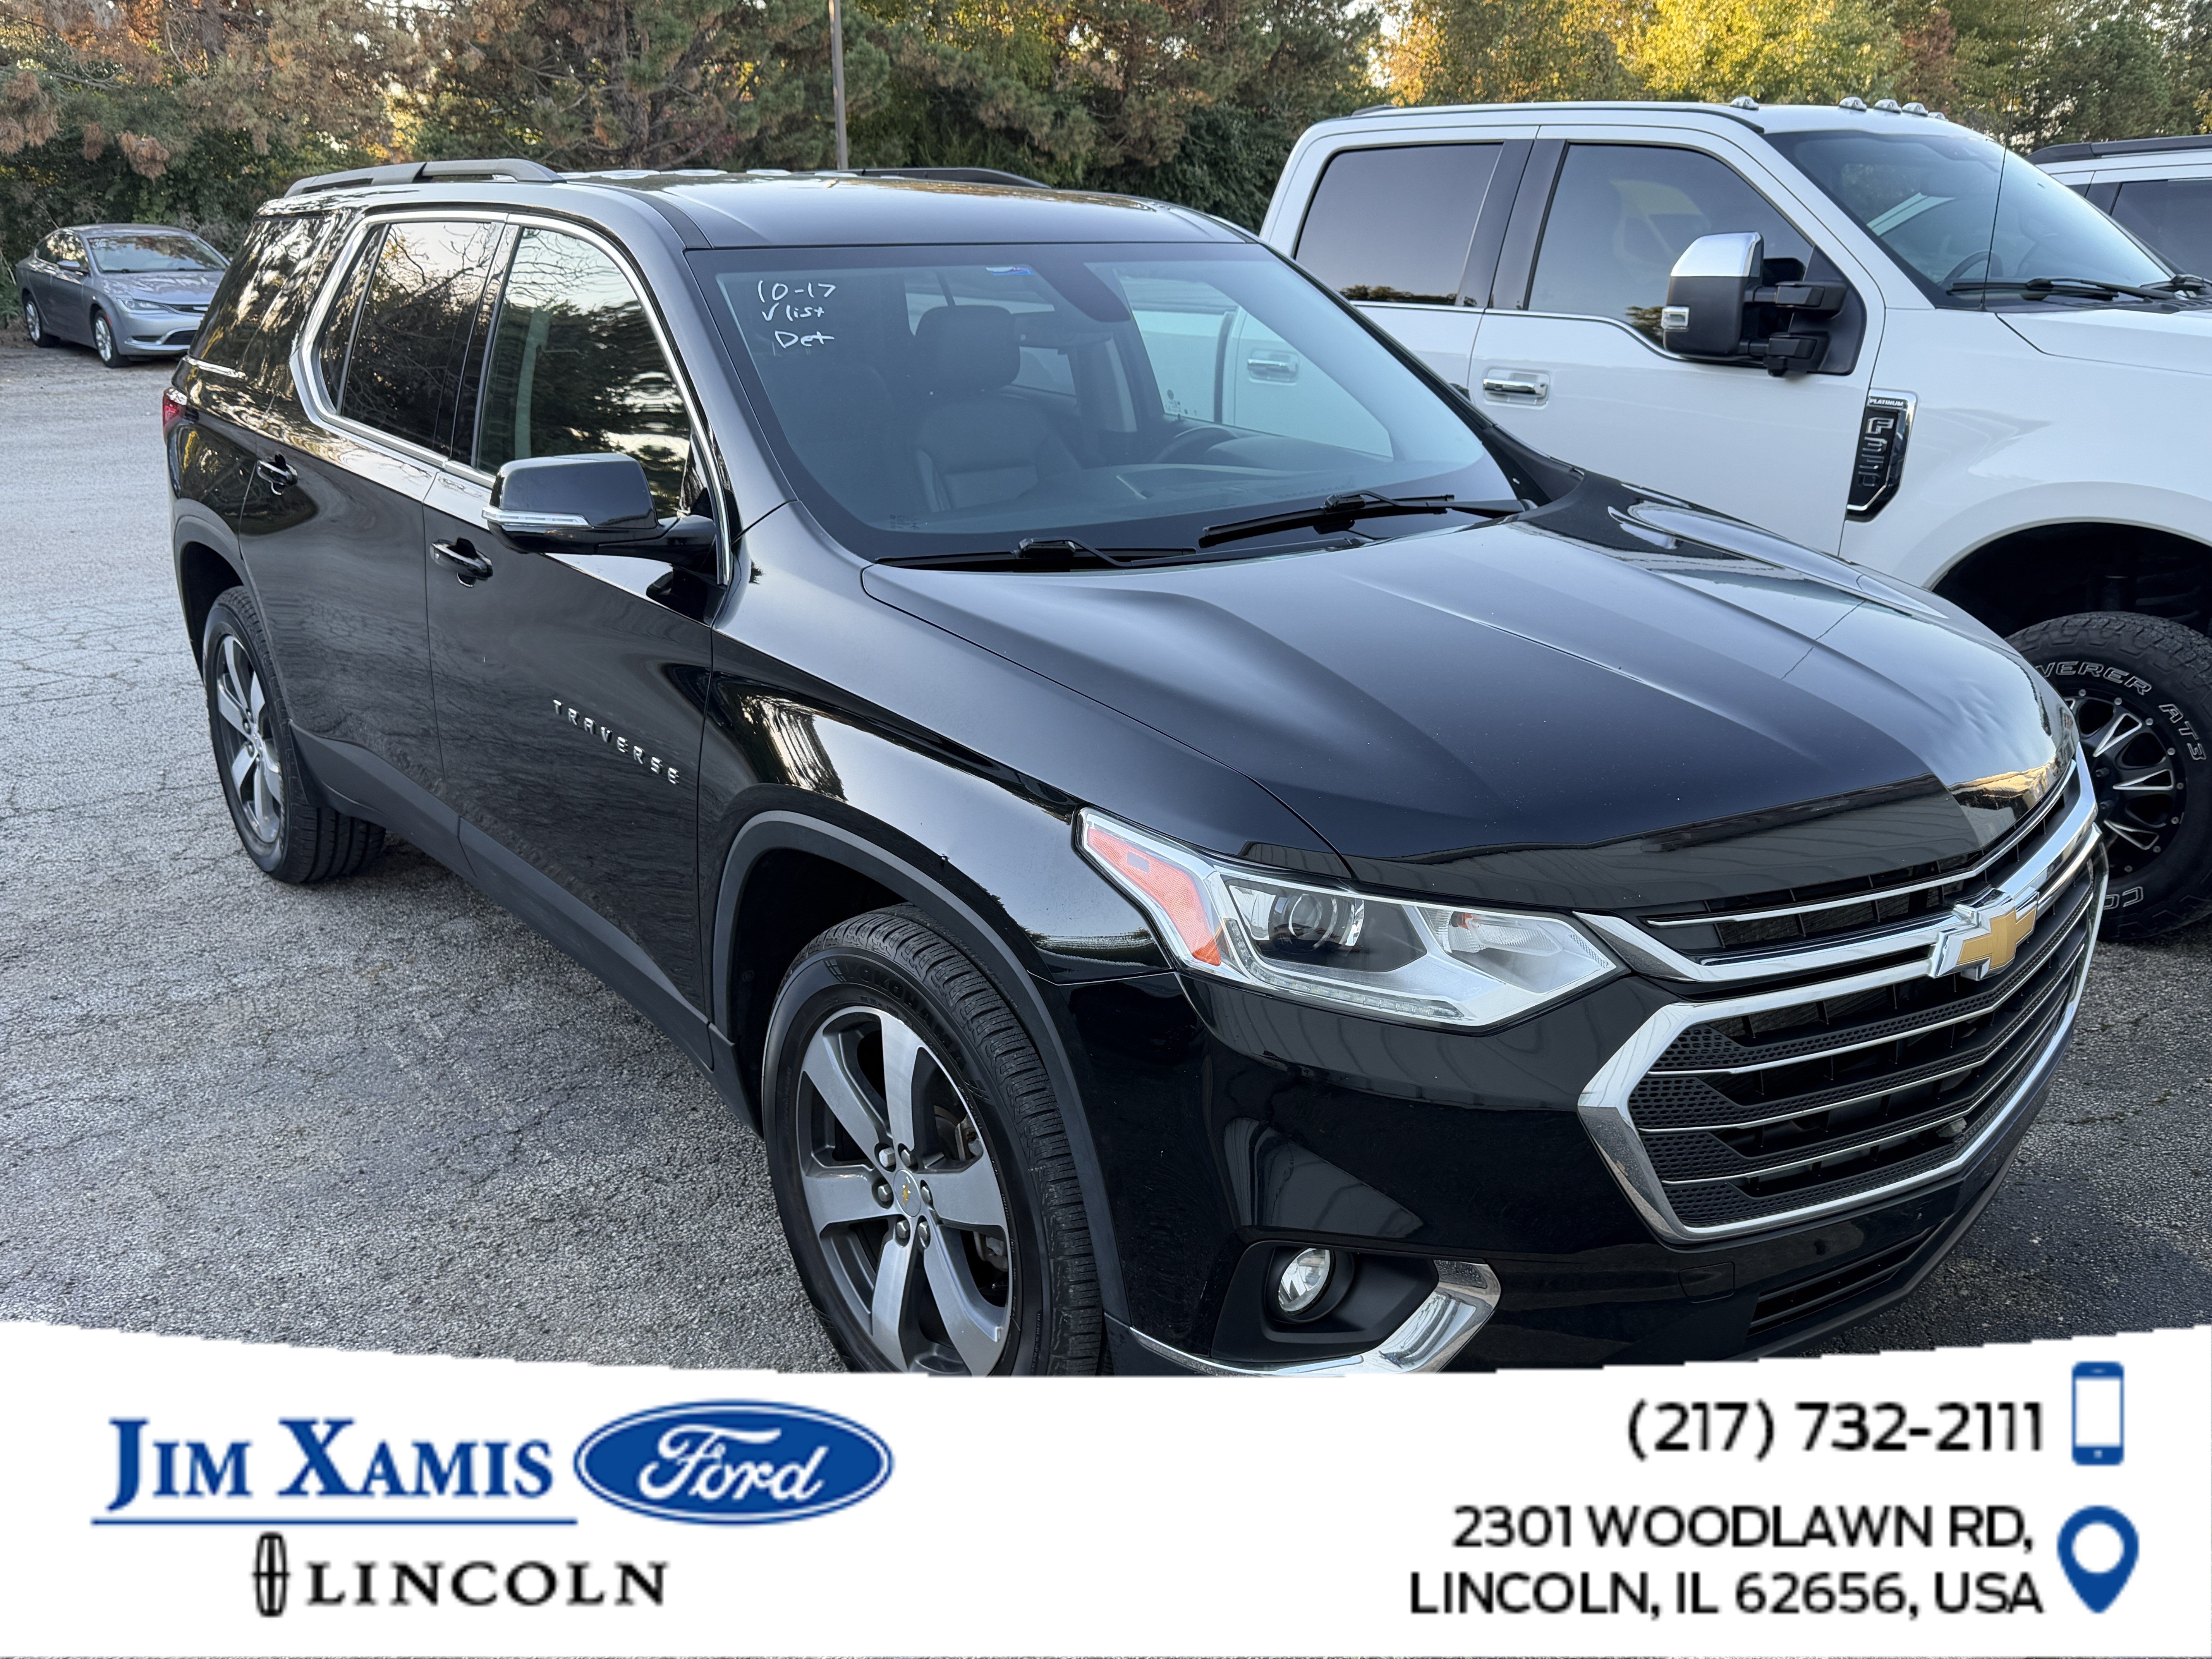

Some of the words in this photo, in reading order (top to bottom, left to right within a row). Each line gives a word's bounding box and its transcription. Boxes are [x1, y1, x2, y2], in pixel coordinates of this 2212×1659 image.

[757, 280, 836, 303] 10-17
[775, 330, 835, 349] Det
[1869, 398, 1904, 407] PLATINUM
[553, 699, 680, 785] TRAVERSE
[2158, 704, 2207, 760] AT3
[844, 963, 967, 1073] YOKOHAMA
